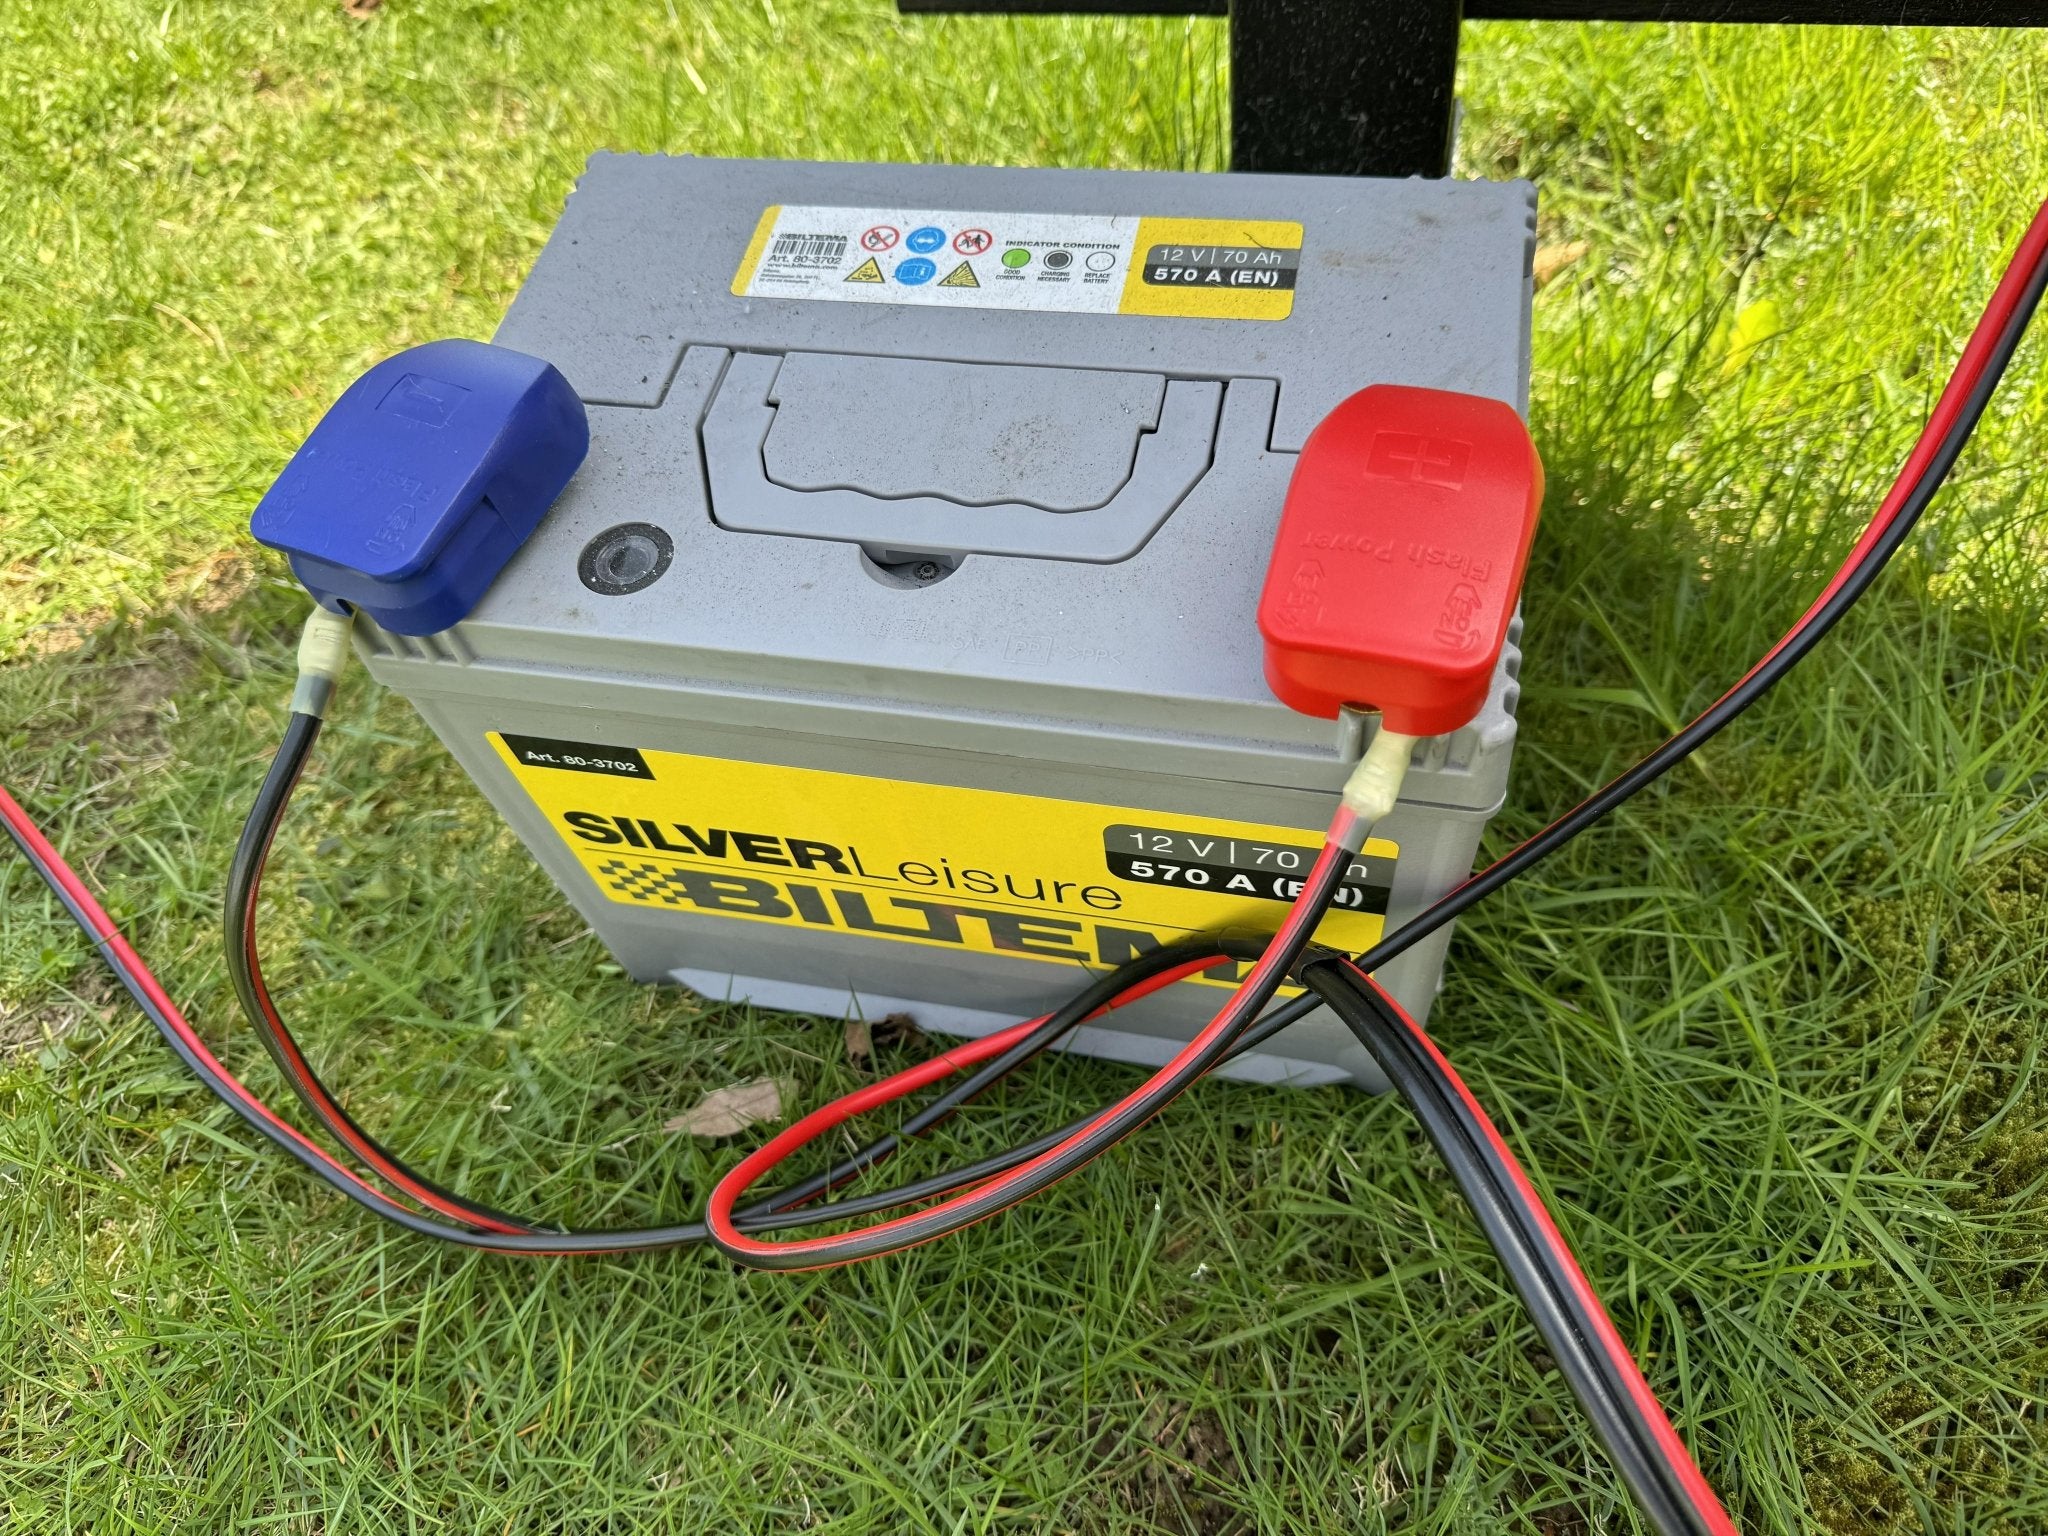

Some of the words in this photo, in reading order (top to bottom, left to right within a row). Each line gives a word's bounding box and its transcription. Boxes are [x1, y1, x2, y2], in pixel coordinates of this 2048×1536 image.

[784, 233, 848, 242] BILTEMA
[1005, 240, 1060, 248] INDICATOR
[1063, 242, 1120, 250] CONDITION
[768, 254, 790, 263] Art.
[792, 256, 842, 265] 80-3702
[1160, 248, 1183, 262] 12
[1191, 248, 1206, 262] V
[1223, 250, 1248, 264] 70
[1253, 251, 1282, 265] Ah
[1153, 267, 1198, 281] 570
[1205, 269, 1222, 283] A
[1229, 271, 1280, 287] (EN)
[526, 750, 561, 764] Art.
[563, 755, 640, 773] 80-3702
[1129, 832, 1174, 854] 12
[1187, 839, 1216, 859] V
[1252, 847, 1300, 870] 70
[1129, 861, 1210, 885] 570
[1225, 872, 1257, 892] A
